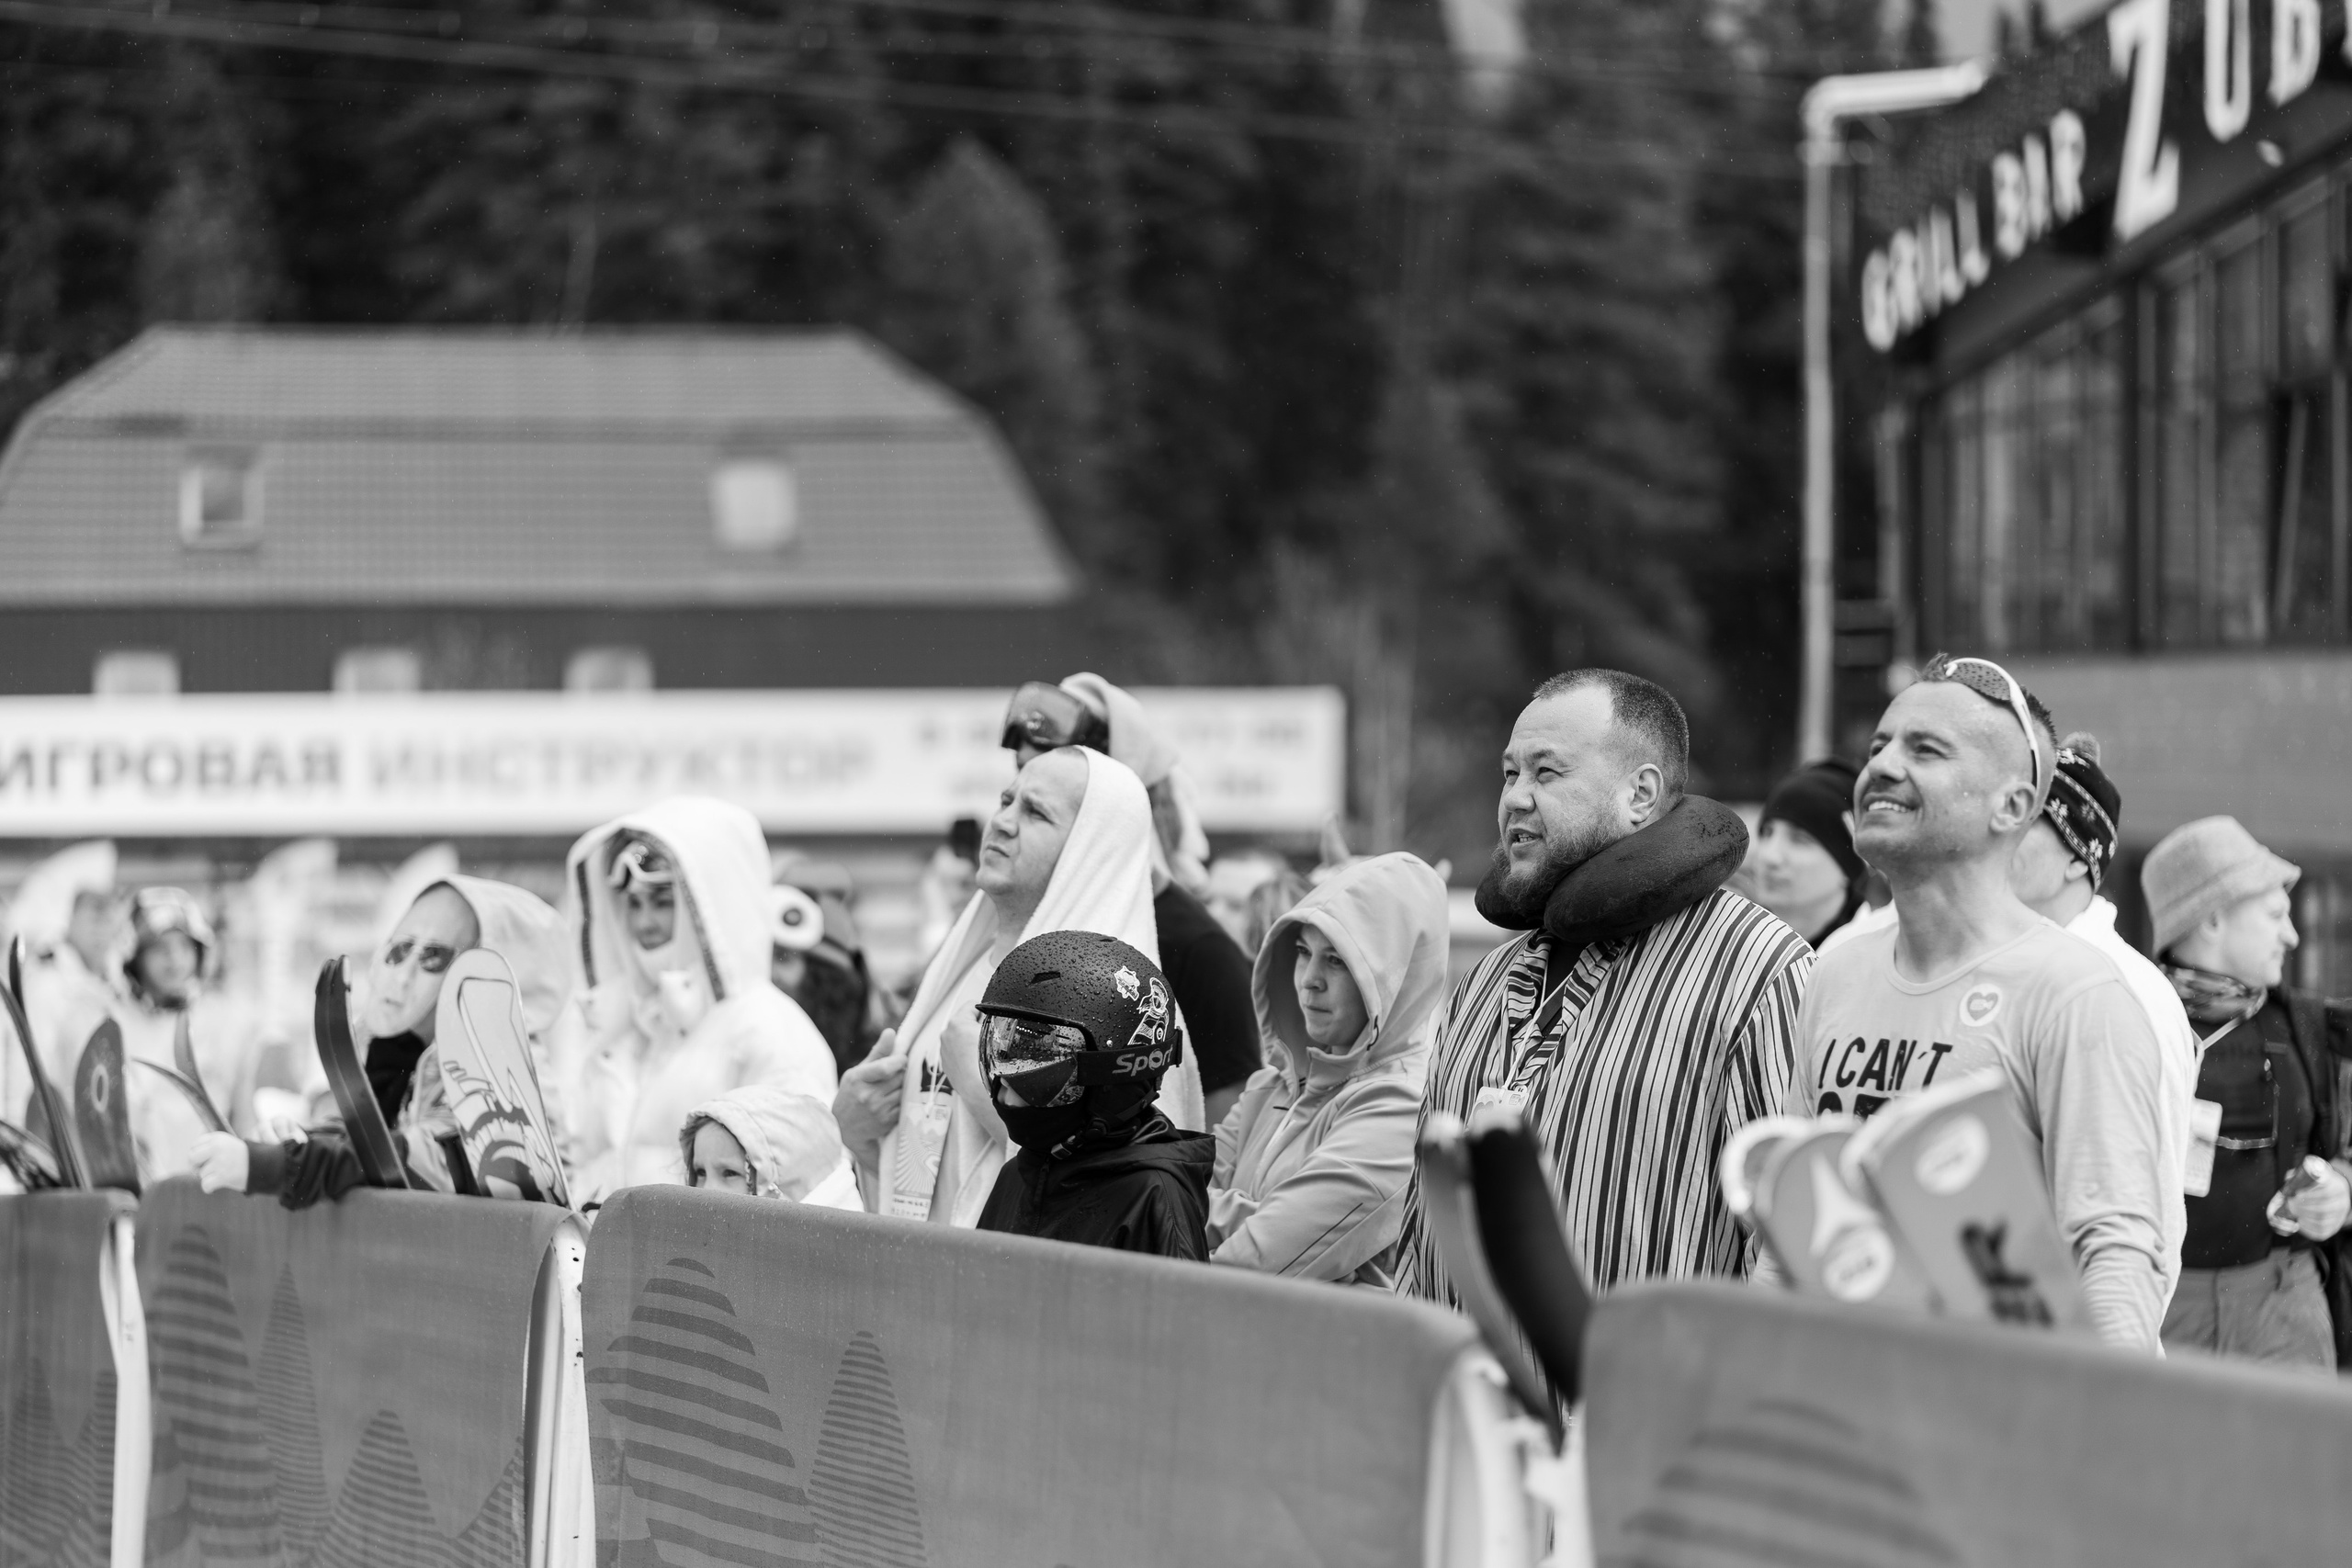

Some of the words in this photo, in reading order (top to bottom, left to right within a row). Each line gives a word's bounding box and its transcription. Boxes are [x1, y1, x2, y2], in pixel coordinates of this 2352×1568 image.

[1861, 189, 1990, 352] GRILL
[1992, 108, 2086, 261] BAR
[2107, 0, 2352, 243] ZUB
[1817, 1038, 1837, 1089] I
